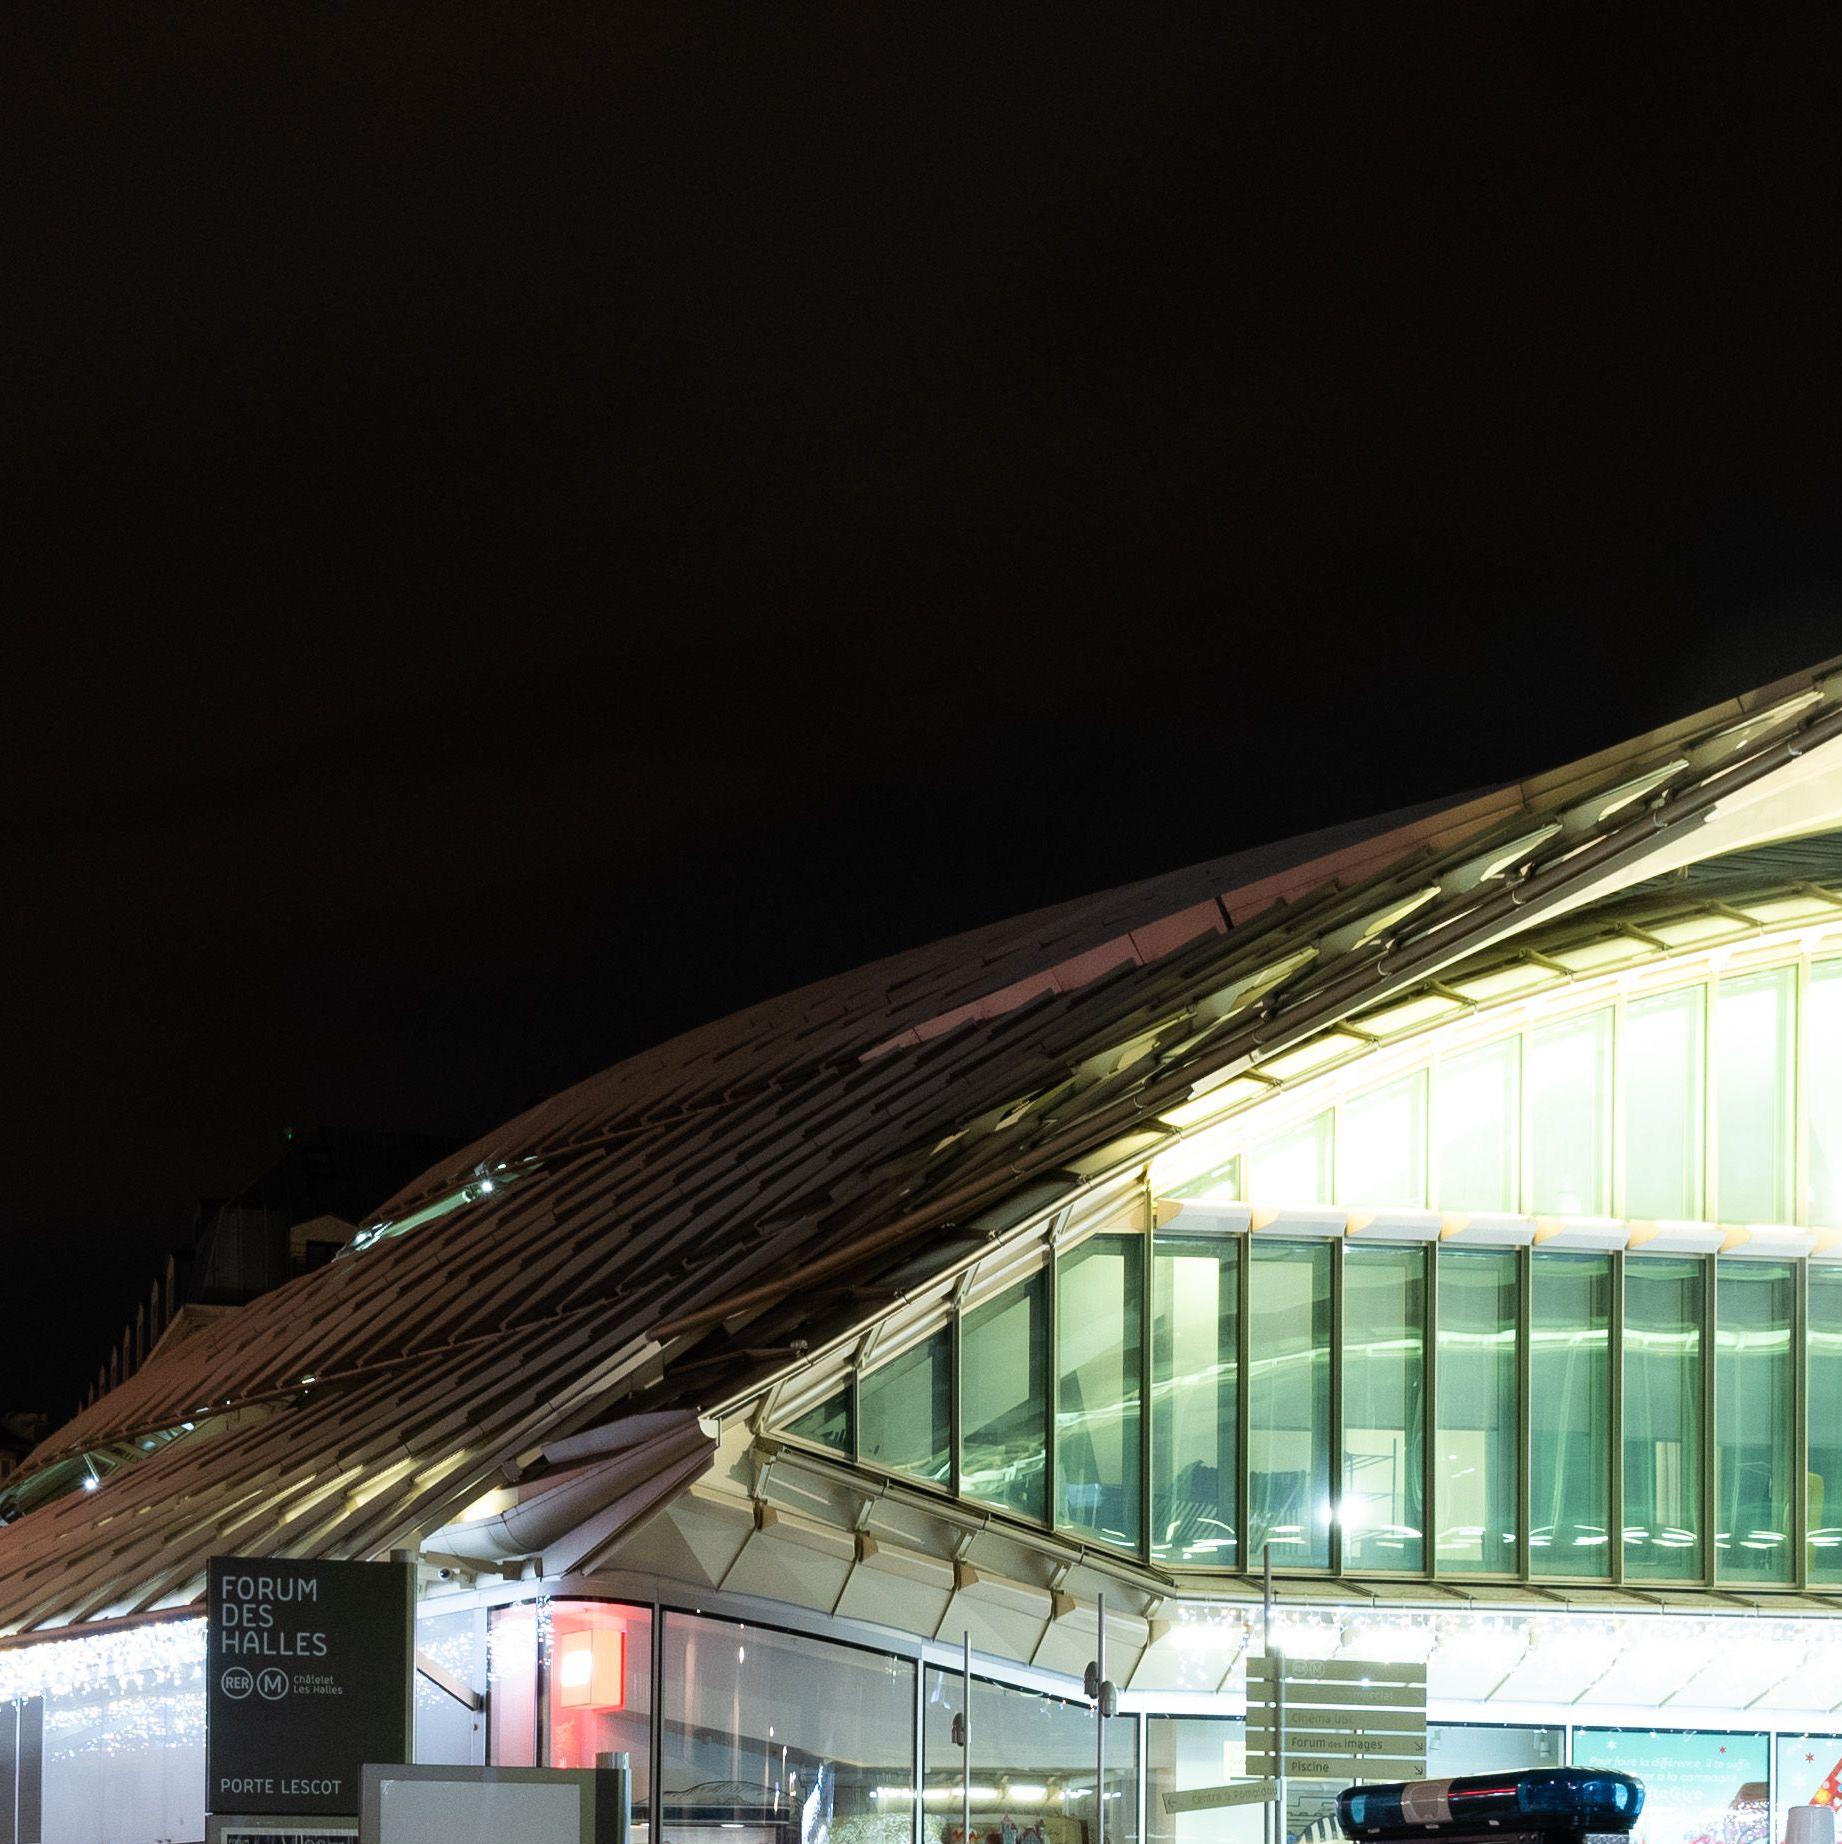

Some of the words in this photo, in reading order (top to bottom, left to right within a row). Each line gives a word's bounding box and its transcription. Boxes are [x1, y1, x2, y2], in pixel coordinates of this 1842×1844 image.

[222, 1576, 317, 1602] FORUM
[222, 1603, 274, 1628] DES
[222, 1630, 327, 1657] HALLES
[225, 1676, 250, 1689] RER
[264, 1674, 281, 1693] M
[293, 1674, 334, 1686] Châtelet
[293, 1686, 310, 1694] Les
[313, 1686, 343, 1695] Halles
[1292, 1737, 1326, 1748] Forum
[1292, 1761, 1329, 1773] Piscine
[221, 1778, 274, 1794] PORTE
[281, 1779, 342, 1795] LESCOT
